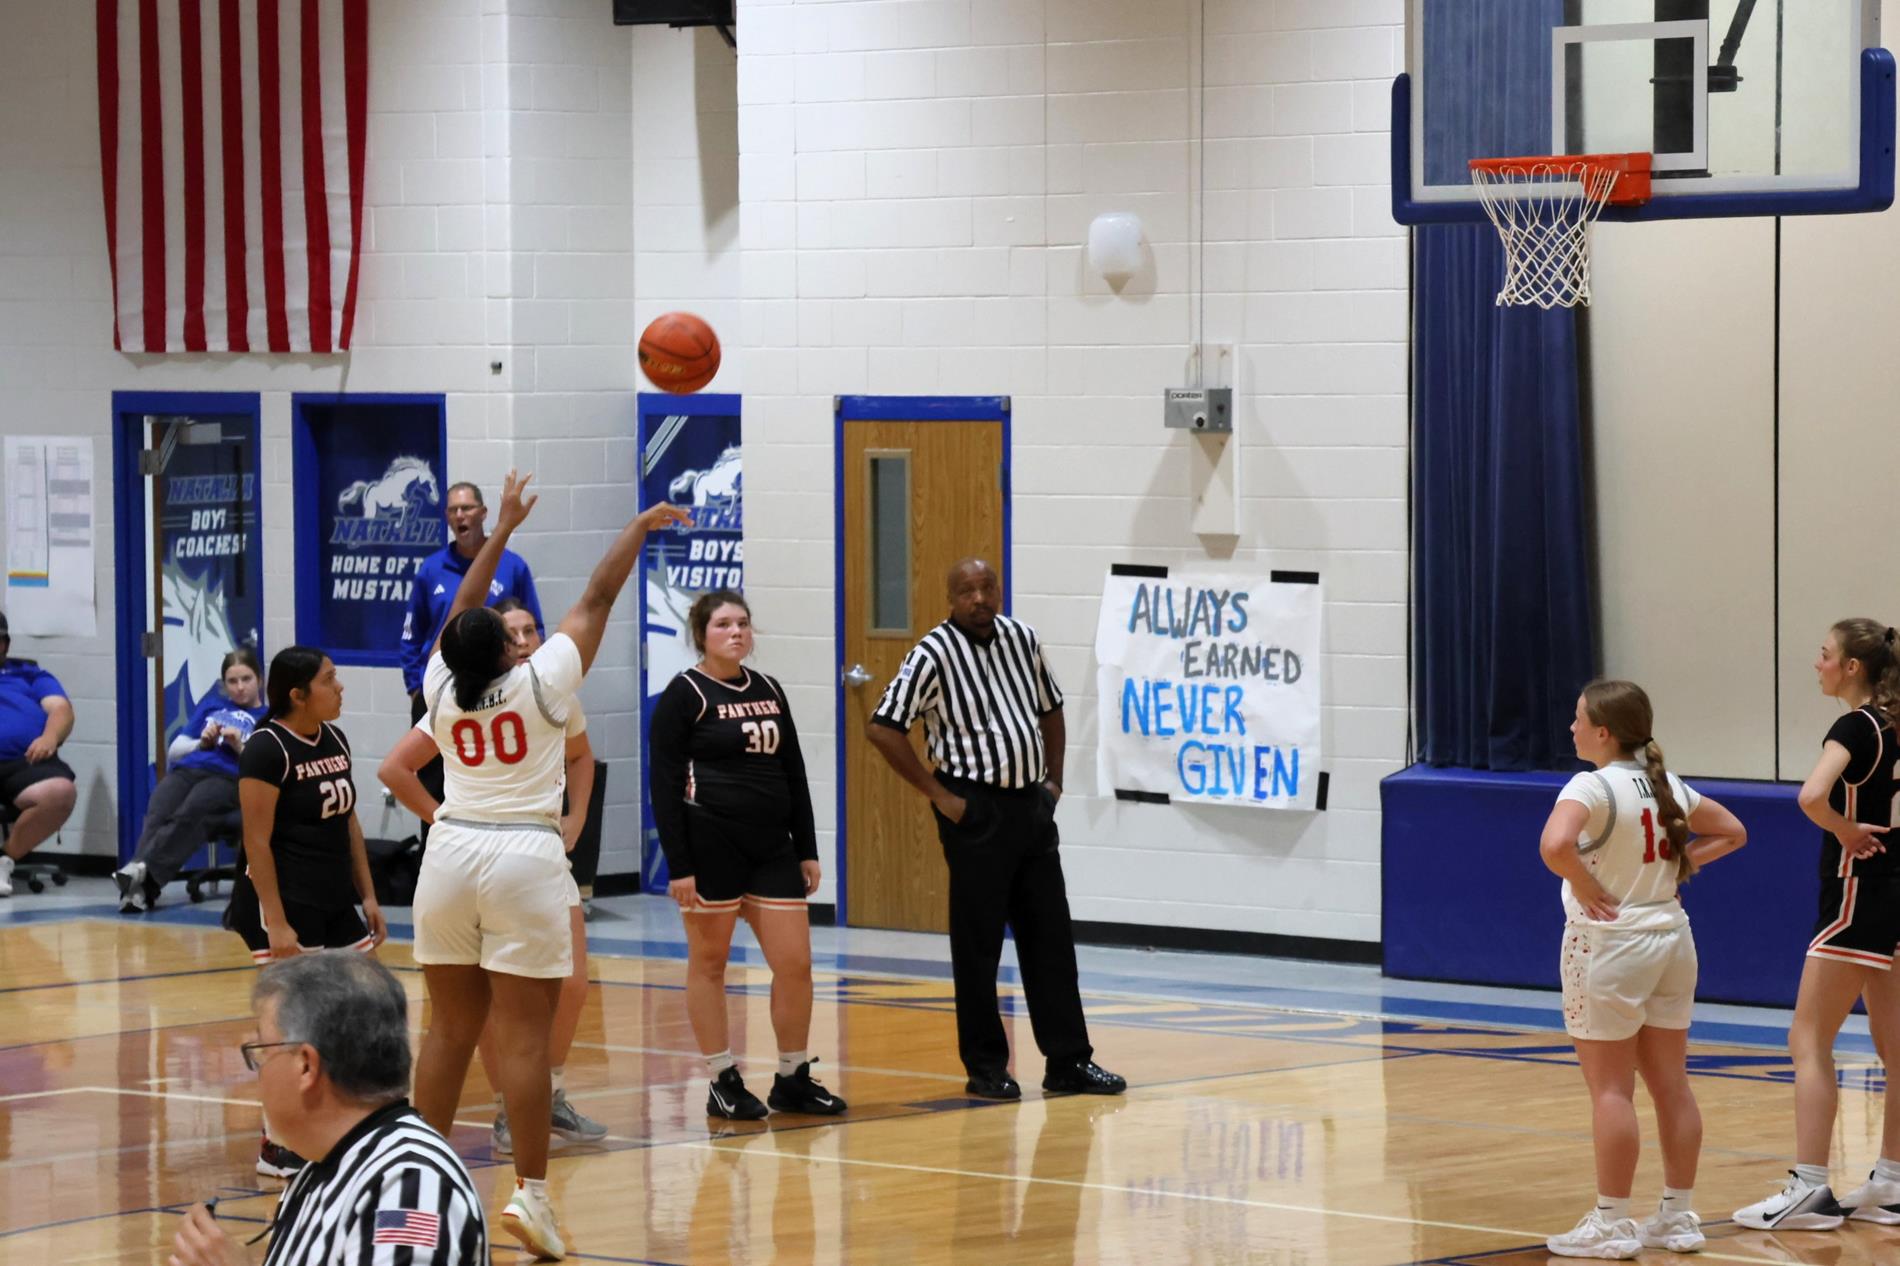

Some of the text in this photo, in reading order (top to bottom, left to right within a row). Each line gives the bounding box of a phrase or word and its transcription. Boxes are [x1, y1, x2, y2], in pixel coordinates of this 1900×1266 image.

[331, 555, 382, 574] HOME
[384, 556, 409, 575] OF
[689, 539, 743, 562] BOYS
[1127, 583, 1249, 639] ALWAYS
[1183, 640, 1302, 684] EARNED
[1121, 677, 1247, 736] NEVER
[451, 711, 528, 767] 00
[741, 720, 780, 755] 30
[295, 754, 349, 780] PANTHERS
[1177, 739, 1299, 800] GIVEN
[319, 778, 353, 819] 20
